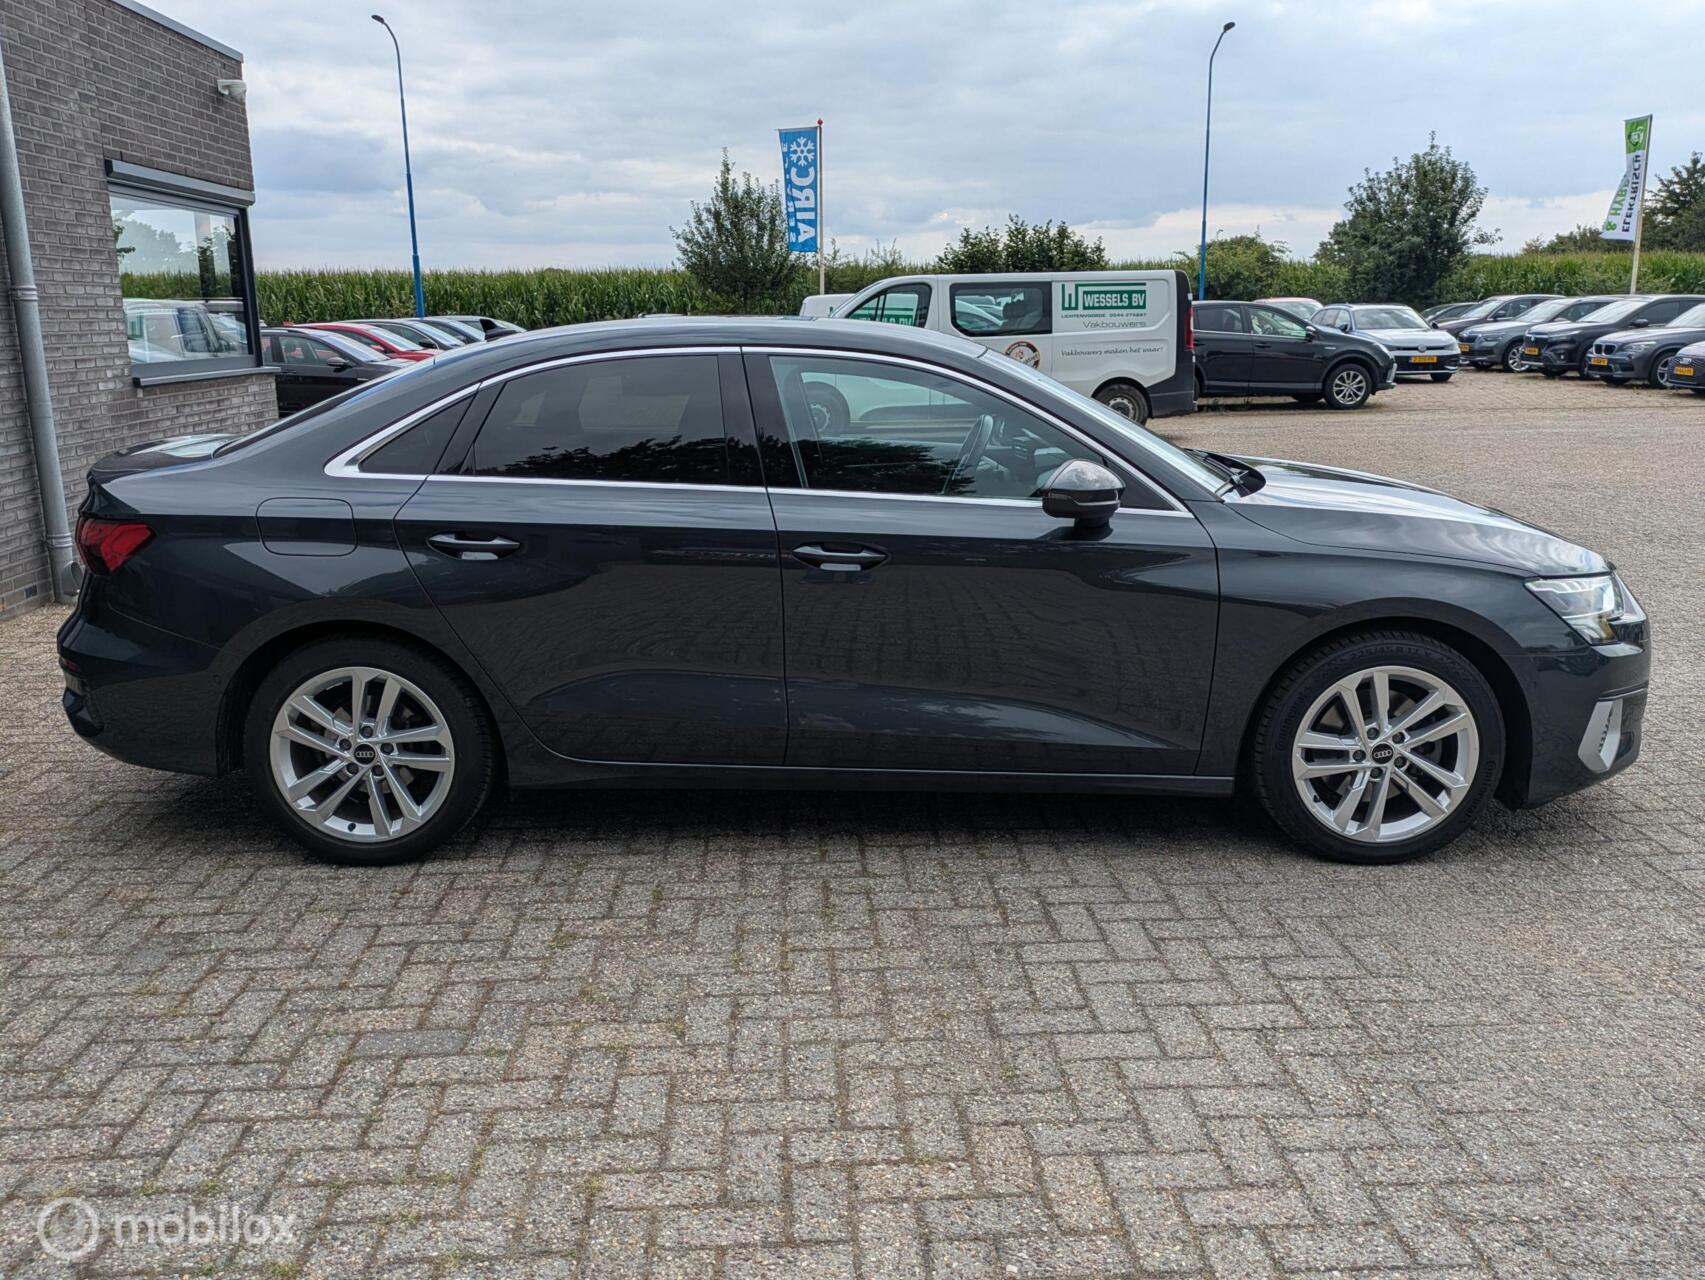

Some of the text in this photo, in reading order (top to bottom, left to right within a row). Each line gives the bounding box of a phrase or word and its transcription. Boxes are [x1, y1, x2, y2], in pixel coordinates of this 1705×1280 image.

[1084, 293, 1145, 307] WESSELS BV
[1083, 321, 1147, 329] Vakbouwers
